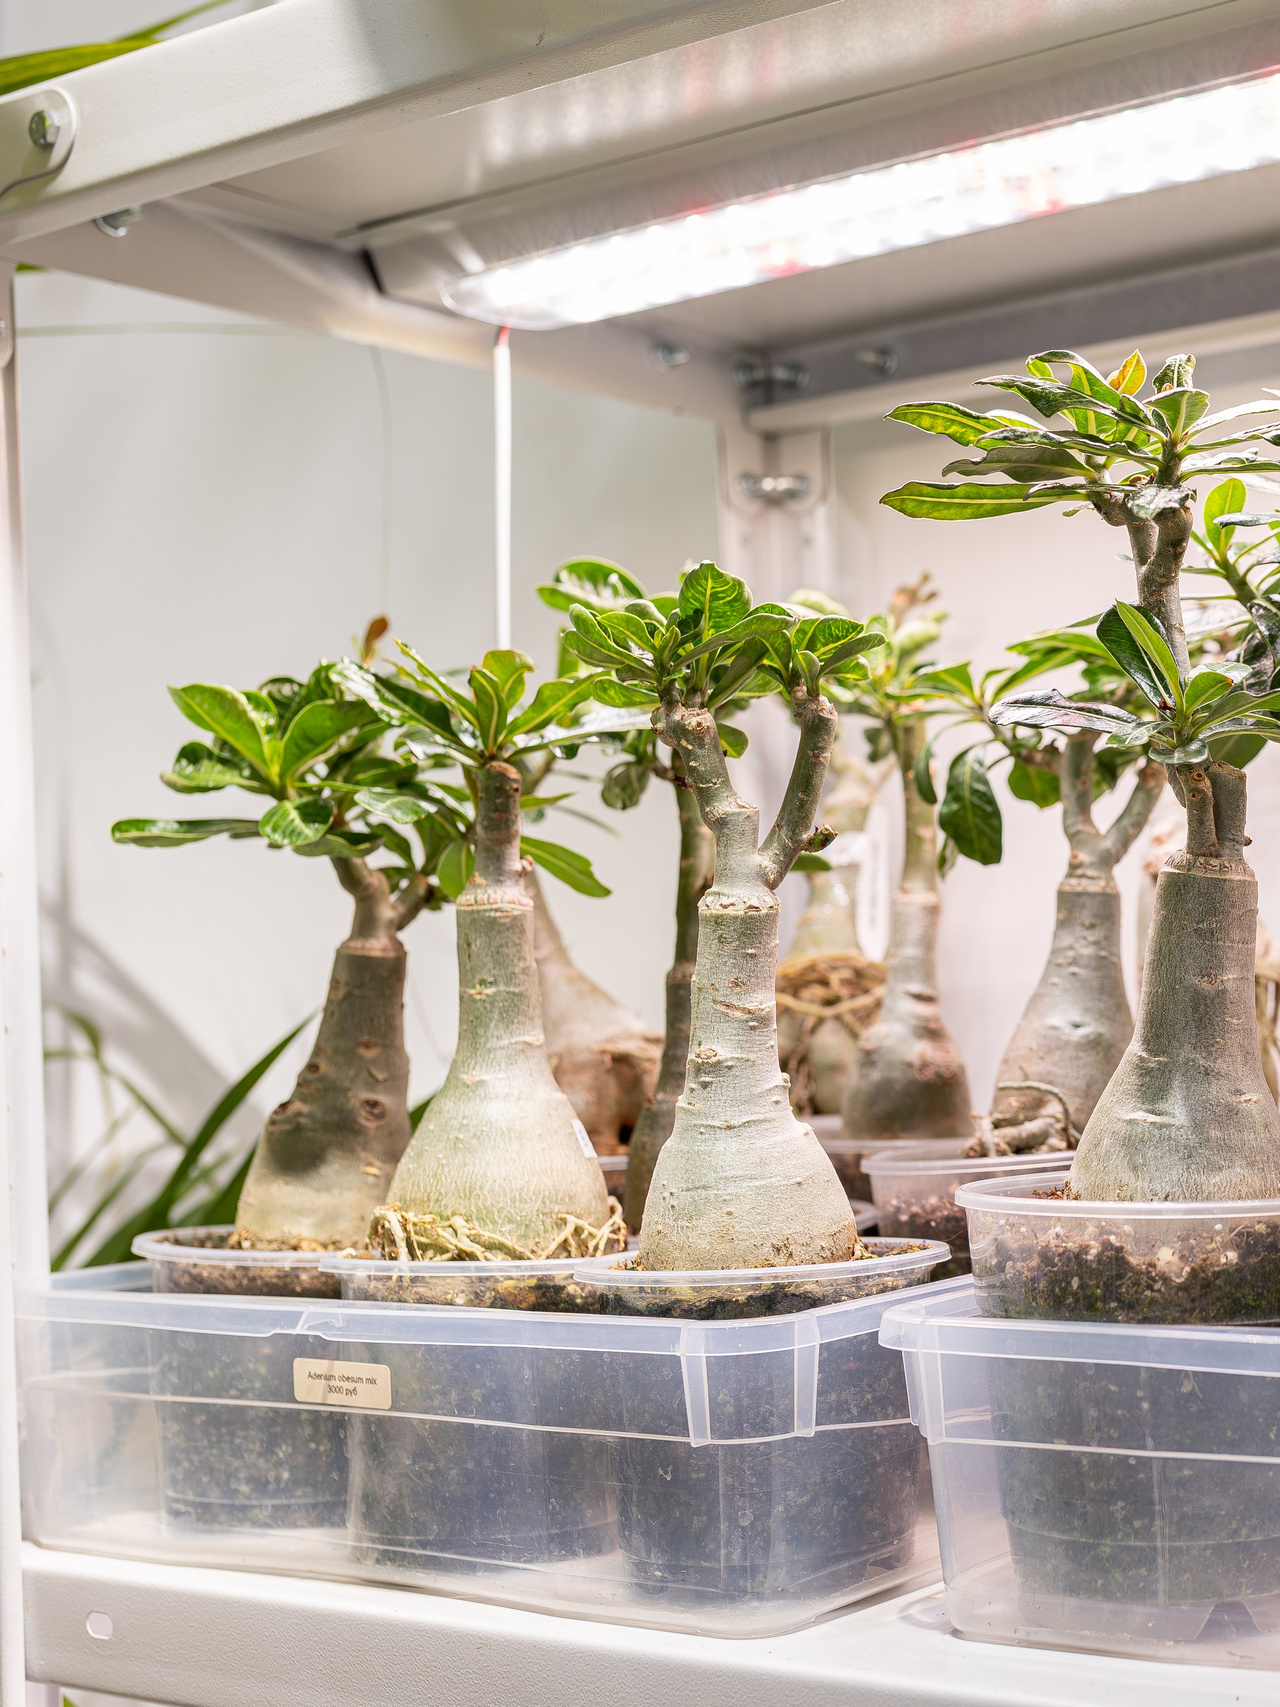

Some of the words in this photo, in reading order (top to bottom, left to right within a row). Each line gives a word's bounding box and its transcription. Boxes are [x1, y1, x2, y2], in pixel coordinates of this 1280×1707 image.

[307, 1371, 337, 1382] Adenium
[337, 1374, 364, 1385] obesum
[365, 1376, 378, 1386] mix
[327, 1384, 344, 1395] 3000
[345, 1386, 358, 1397] руб
